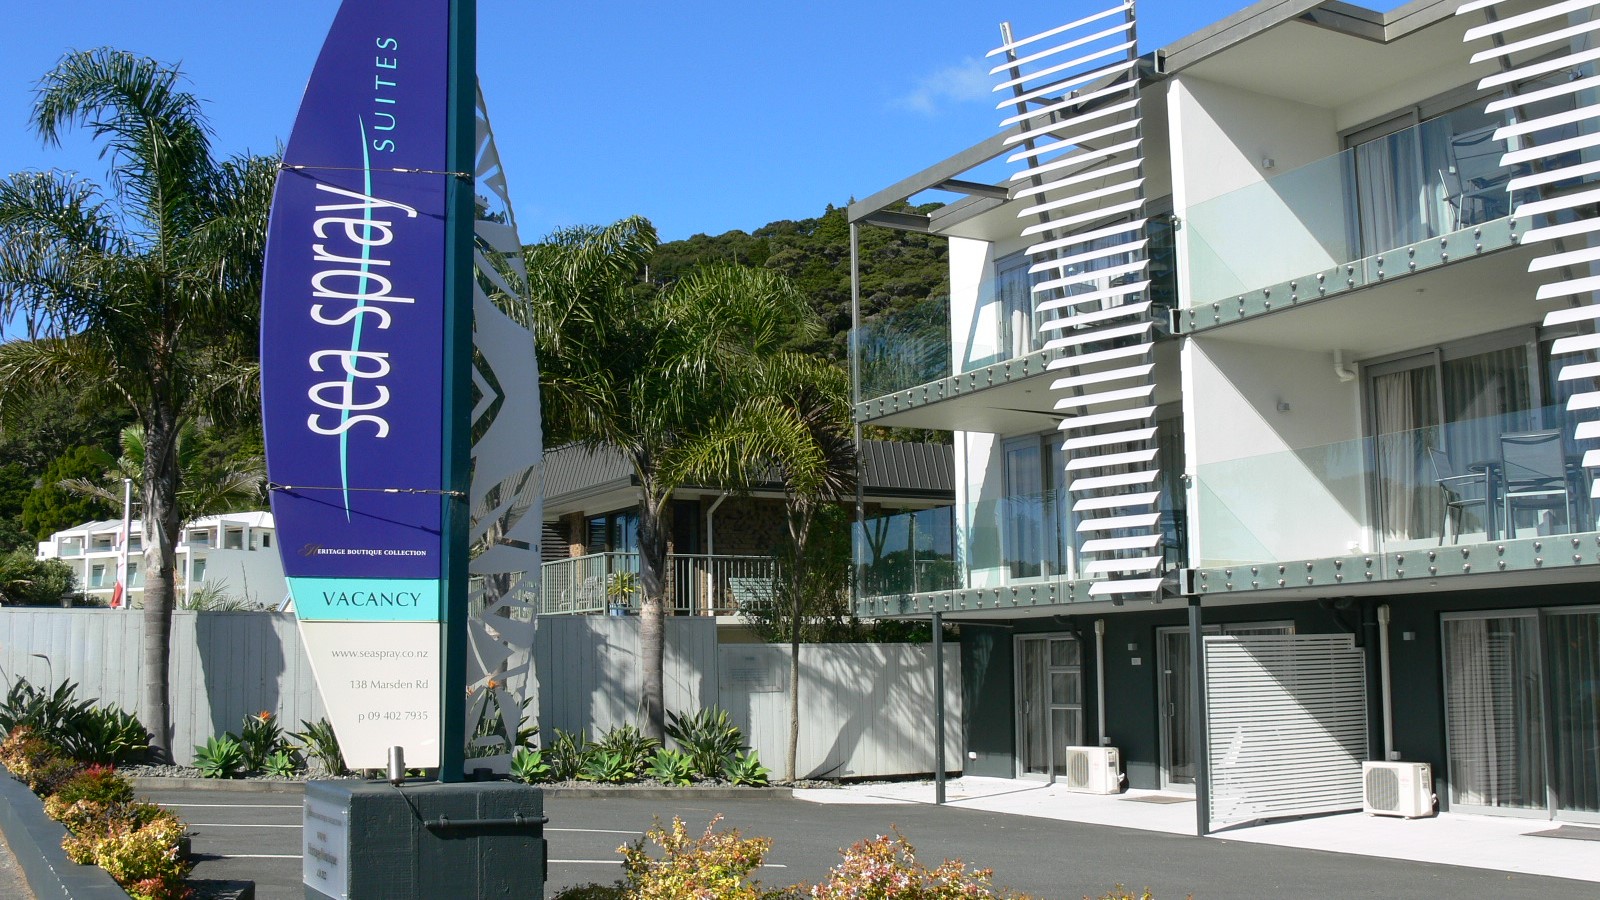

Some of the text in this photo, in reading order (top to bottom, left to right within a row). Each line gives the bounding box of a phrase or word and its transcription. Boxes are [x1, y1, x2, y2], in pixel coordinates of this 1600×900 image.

[373, 37, 398, 153] SUITES
[298, 543, 427, 558] HERITAGE BOUTIQUE COLLECTION
[322, 591, 422, 607] VACANCY
[331, 648, 429, 662] www.seaspray.co.nz
[349, 679, 429, 689] 138 Marsden Rd
[358, 710, 429, 724] p 09 402 7935
